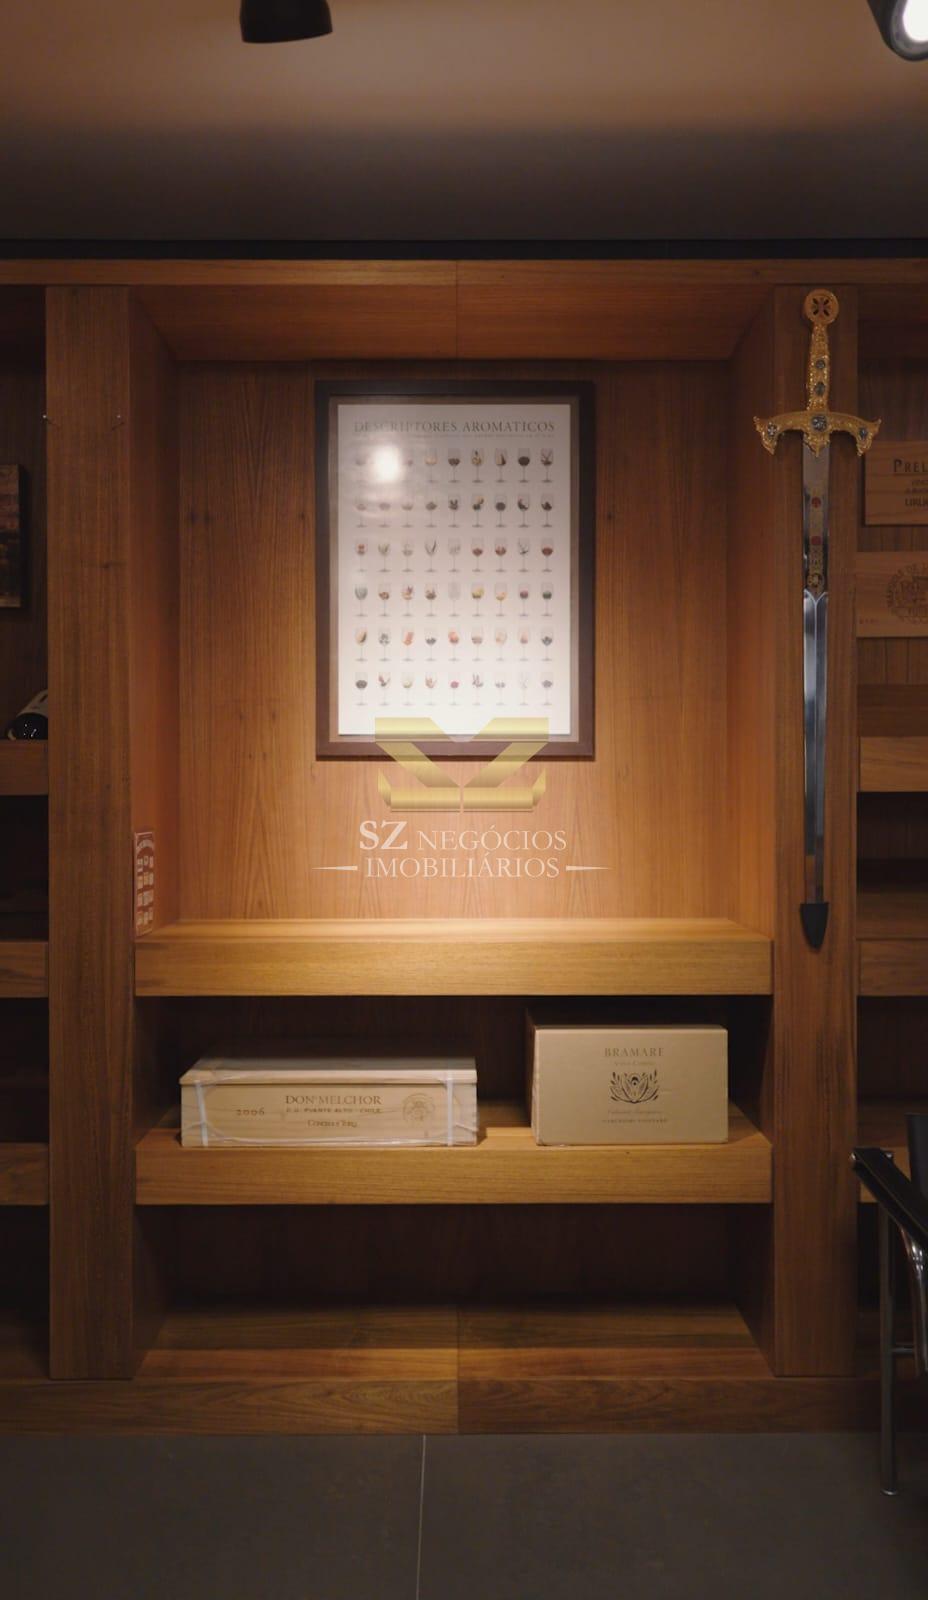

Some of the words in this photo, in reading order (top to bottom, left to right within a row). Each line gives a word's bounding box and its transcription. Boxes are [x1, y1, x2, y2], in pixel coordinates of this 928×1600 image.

[285, 1095, 315, 1105] DON
[317, 1095, 383, 1105] MELCHOR
[236, 1106, 266, 1117] 2006
